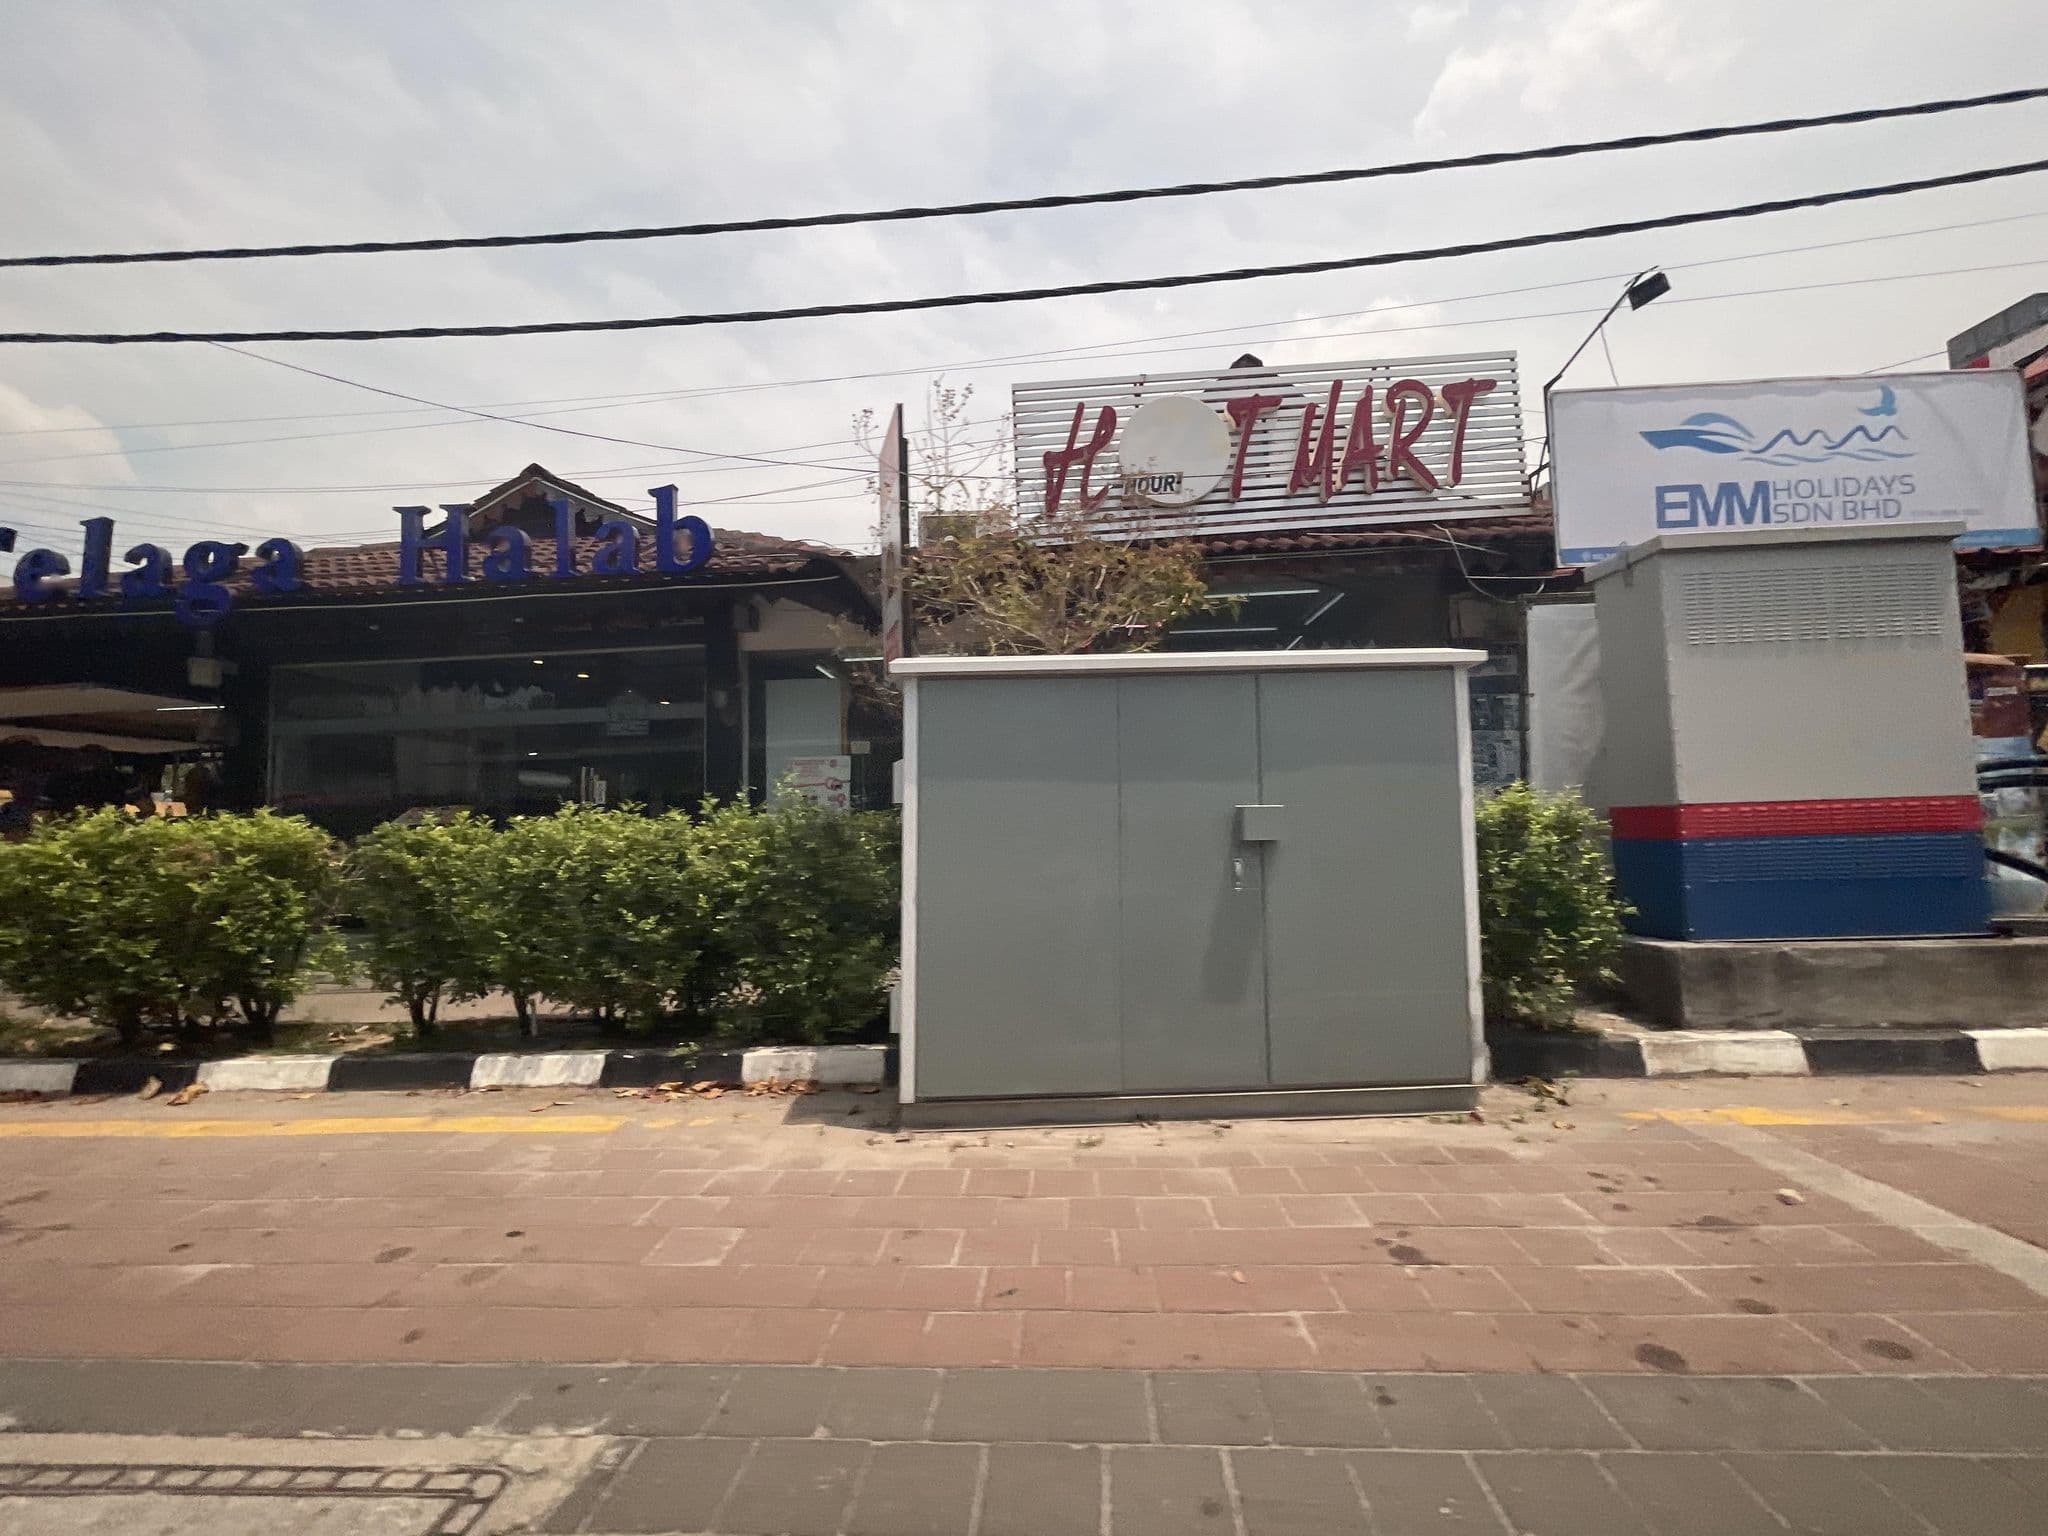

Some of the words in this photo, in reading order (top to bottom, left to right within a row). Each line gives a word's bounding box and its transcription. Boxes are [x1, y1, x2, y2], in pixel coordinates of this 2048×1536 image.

[1287, 379, 1498, 502] MART
[1771, 474, 1917, 501] HOLIDAYS
[1772, 501, 1834, 525] SDN
[1842, 498, 1902, 521] BHD
[392, 484, 714, 586] Halab
